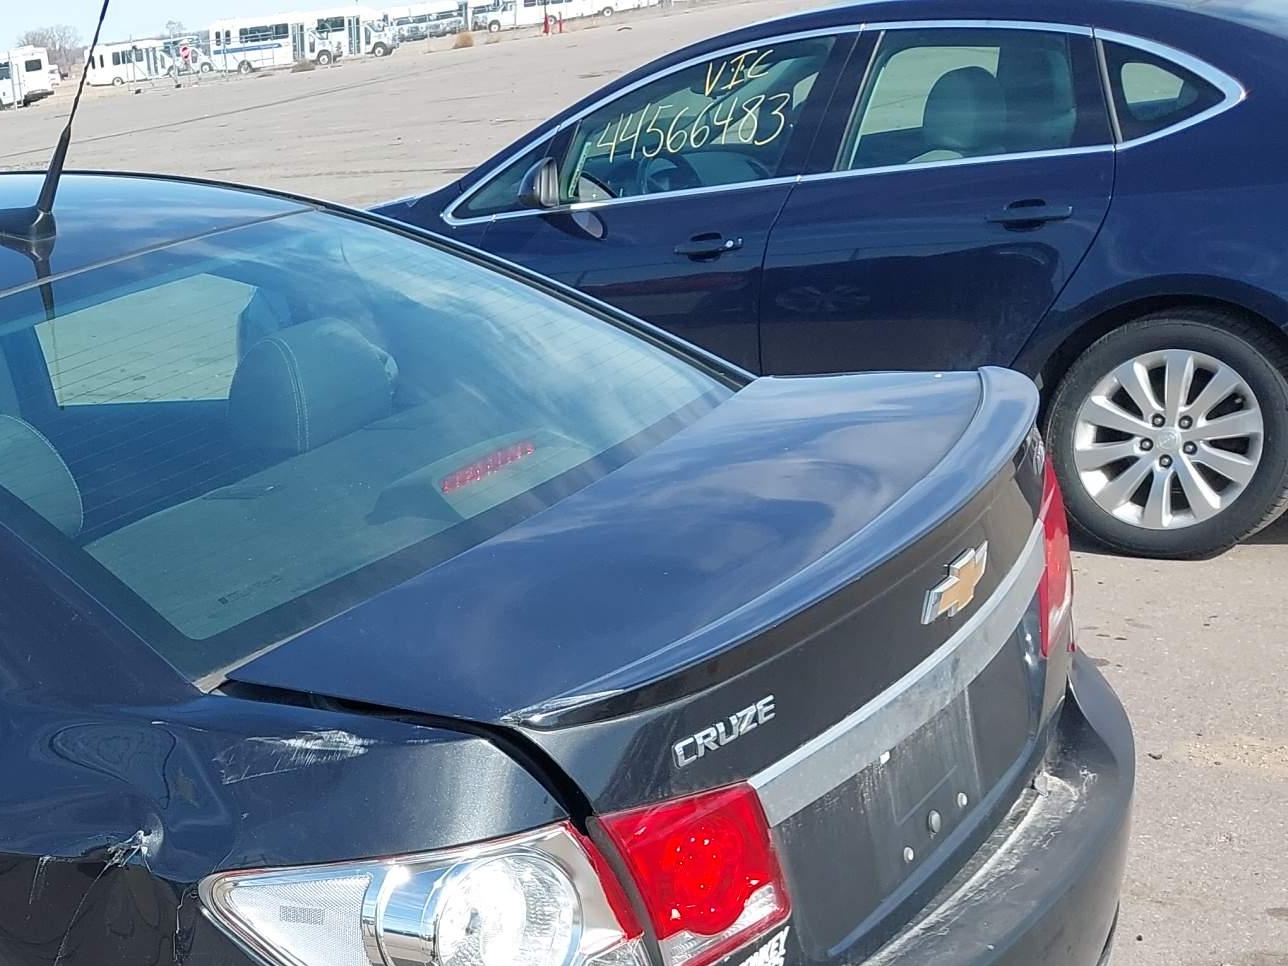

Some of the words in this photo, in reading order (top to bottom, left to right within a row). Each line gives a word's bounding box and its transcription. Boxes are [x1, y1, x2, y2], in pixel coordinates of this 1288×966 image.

[705, 49, 775, 97] VIC
[596, 93, 791, 164] 44566483
[672, 694, 776, 768] CRUZE
